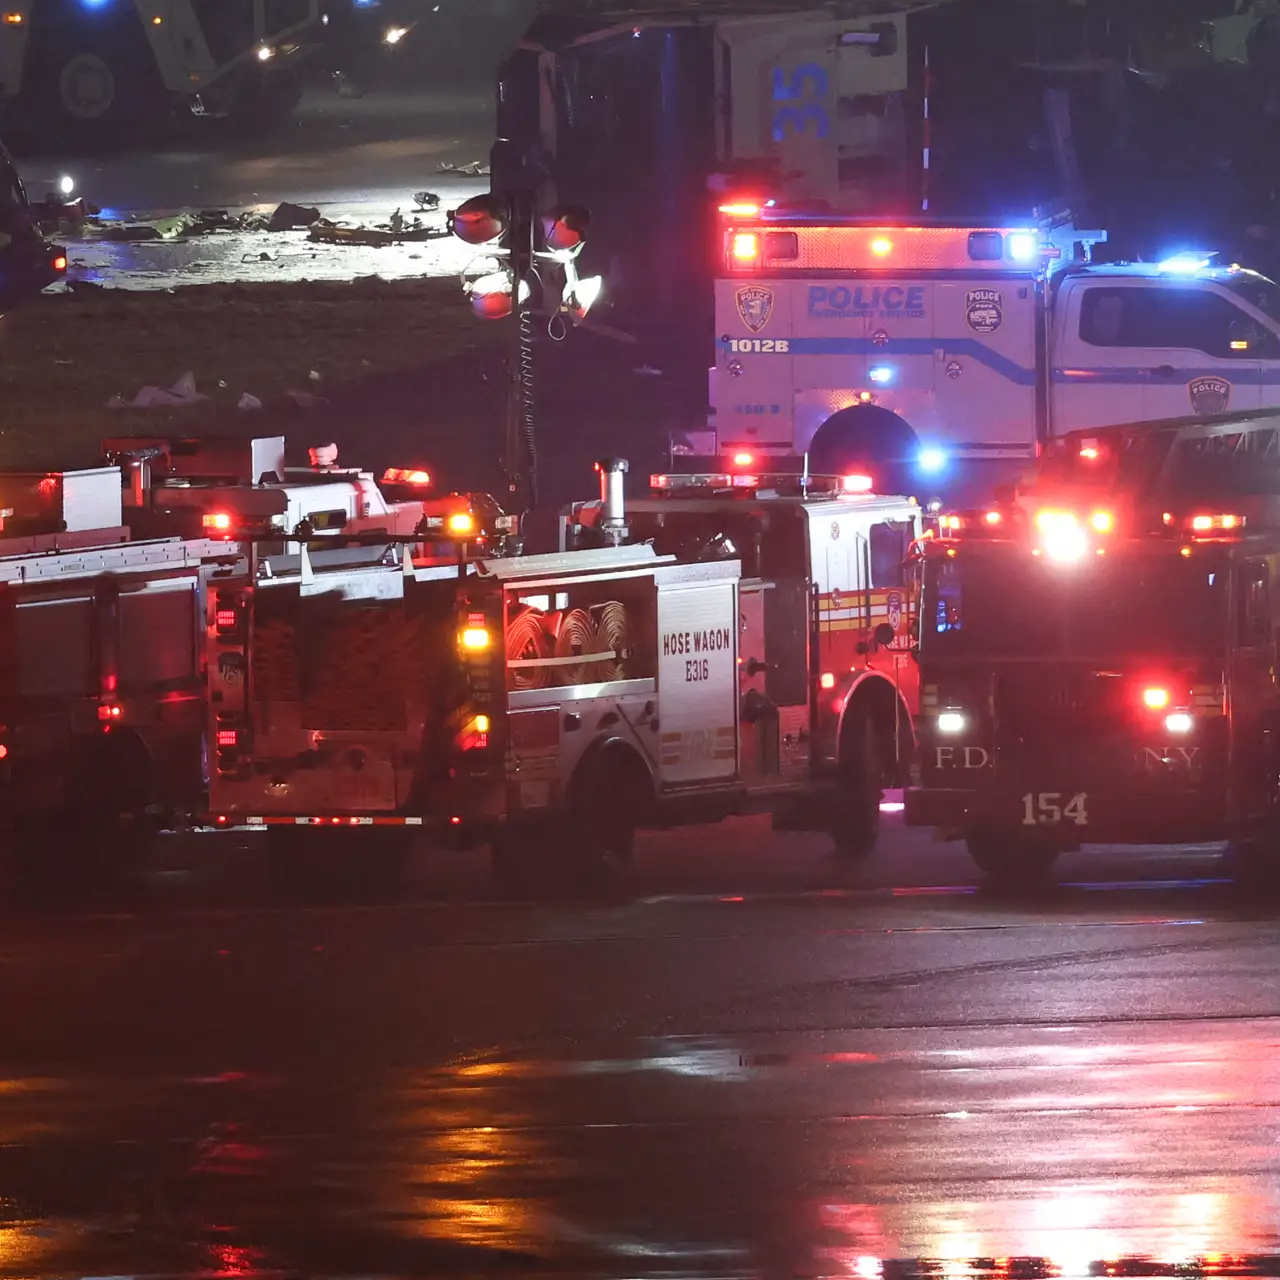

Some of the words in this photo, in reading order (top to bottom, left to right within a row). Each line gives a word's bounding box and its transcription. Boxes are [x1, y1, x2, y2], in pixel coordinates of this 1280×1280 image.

[771, 63, 829, 142] 35
[740, 290, 770, 301] POLICE
[808, 285, 926, 310] POLICE
[969, 291, 1000, 301] POLICE
[728, 339, 790, 353] 1012B
[1192, 383, 1226, 394] POLICE
[663, 632, 691, 656] HOSE
[694, 628, 730, 653] WAGON
[685, 659, 709, 682] E316
[935, 746, 994, 769] F.D.
[1021, 791, 1089, 826] 154
